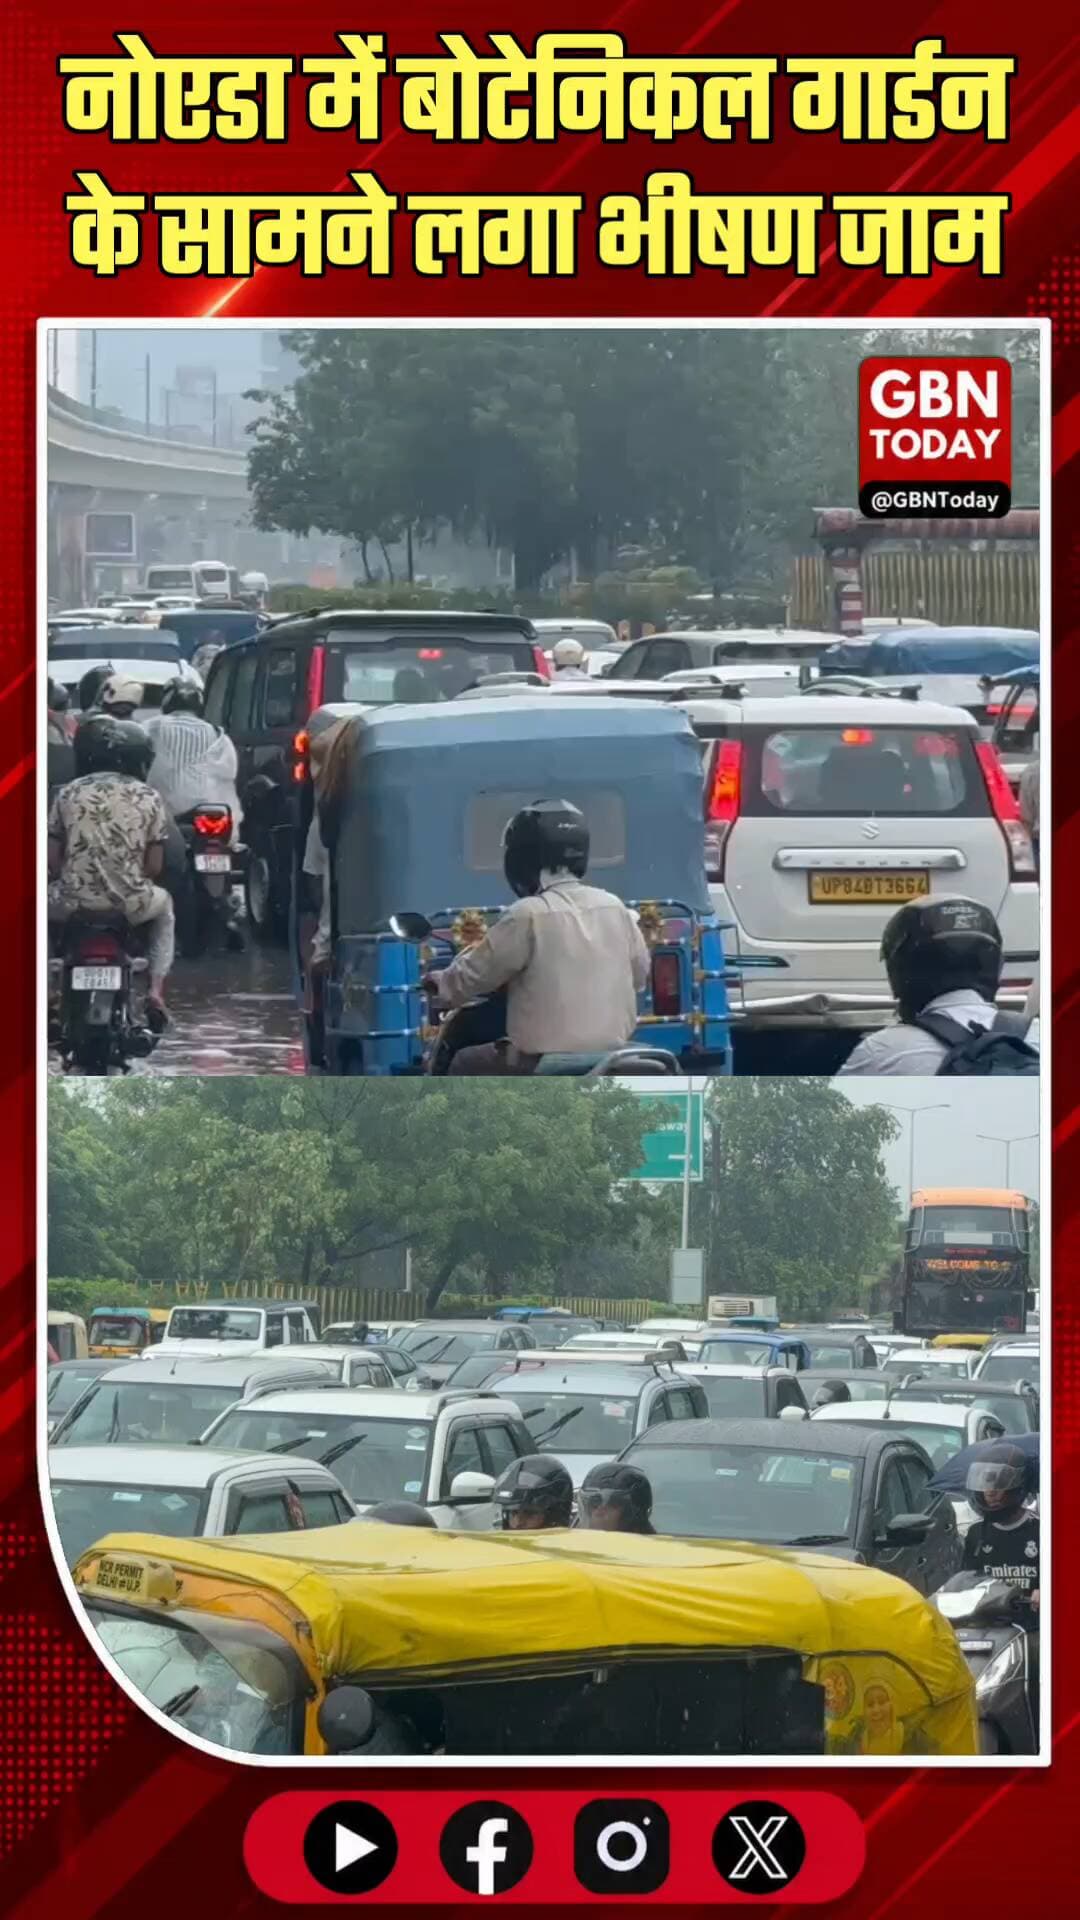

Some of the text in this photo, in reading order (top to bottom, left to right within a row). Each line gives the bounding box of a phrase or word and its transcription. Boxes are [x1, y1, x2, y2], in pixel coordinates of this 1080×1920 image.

[99, 1560, 144, 1579] NCR PERMIT
[983, 1563, 1037, 1578] Emirates
[96, 1572, 118, 1589] DELHI
